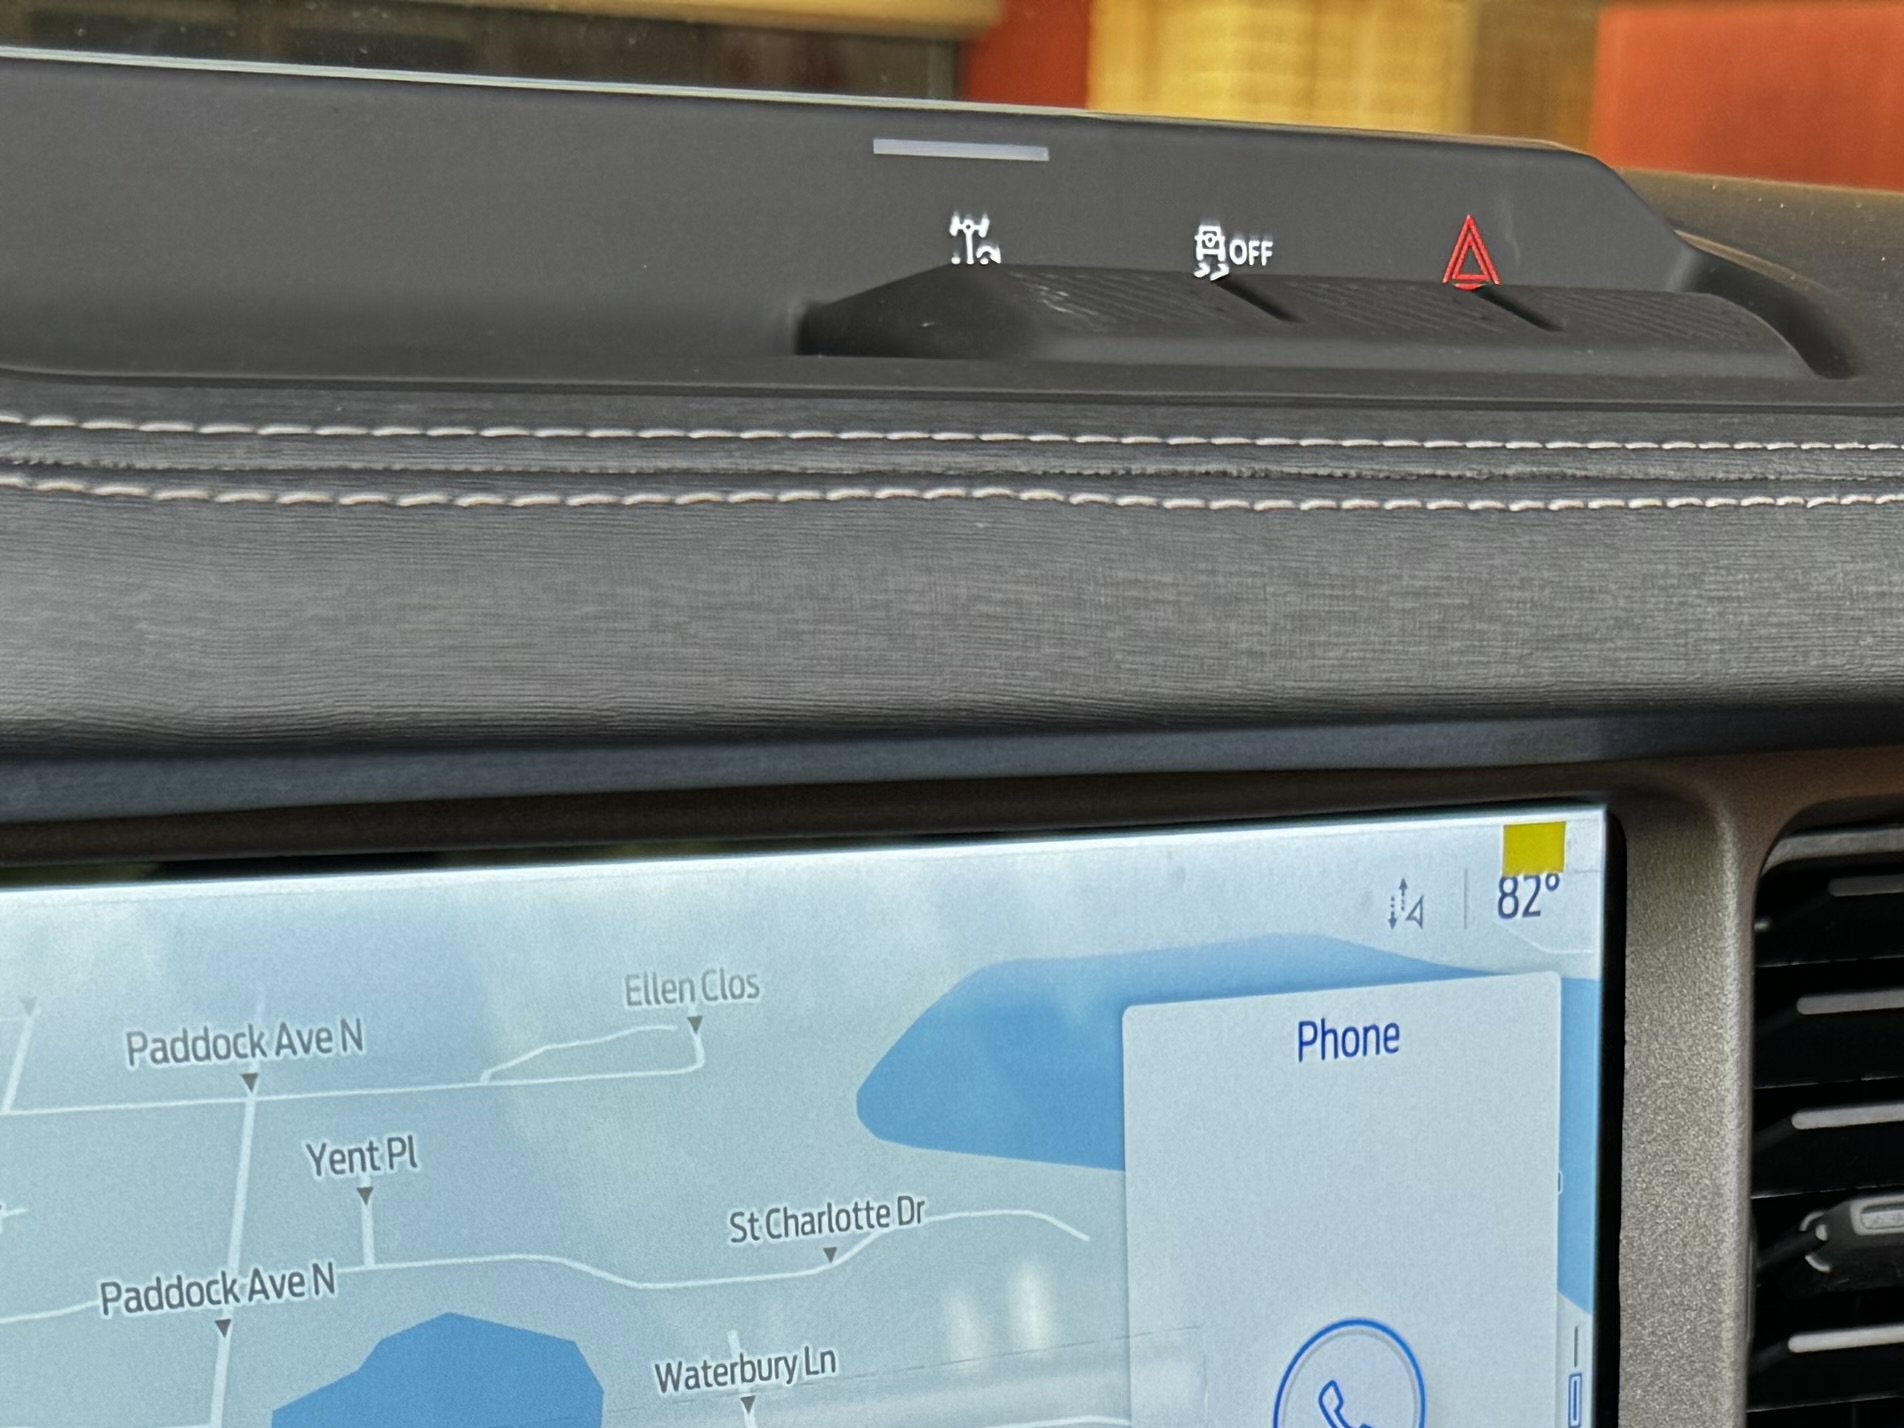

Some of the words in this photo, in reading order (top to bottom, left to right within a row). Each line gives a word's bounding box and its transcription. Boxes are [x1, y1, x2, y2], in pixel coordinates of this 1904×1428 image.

[1229, 238, 1274, 266] OFF
[625, 972, 695, 1008] Ellen
[701, 969, 760, 1000] Clos
[126, 1027, 266, 1066] Paddock
[271, 1023, 333, 1057] Ave
[339, 1018, 364, 1053] N
[1298, 1018, 1401, 1063] Phone
[306, 1139, 378, 1177] Yent
[386, 1134, 418, 1170] Pl
[729, 1211, 761, 1243] St
[765, 1202, 891, 1240] Charlotte
[897, 1196, 925, 1226] Dr
[99, 1273, 240, 1315] Paddock
[248, 1266, 305, 1302] Ave
[312, 1262, 335, 1294] N
[655, 1347, 798, 1394] Waterbury
[804, 1347, 836, 1376] Ln
